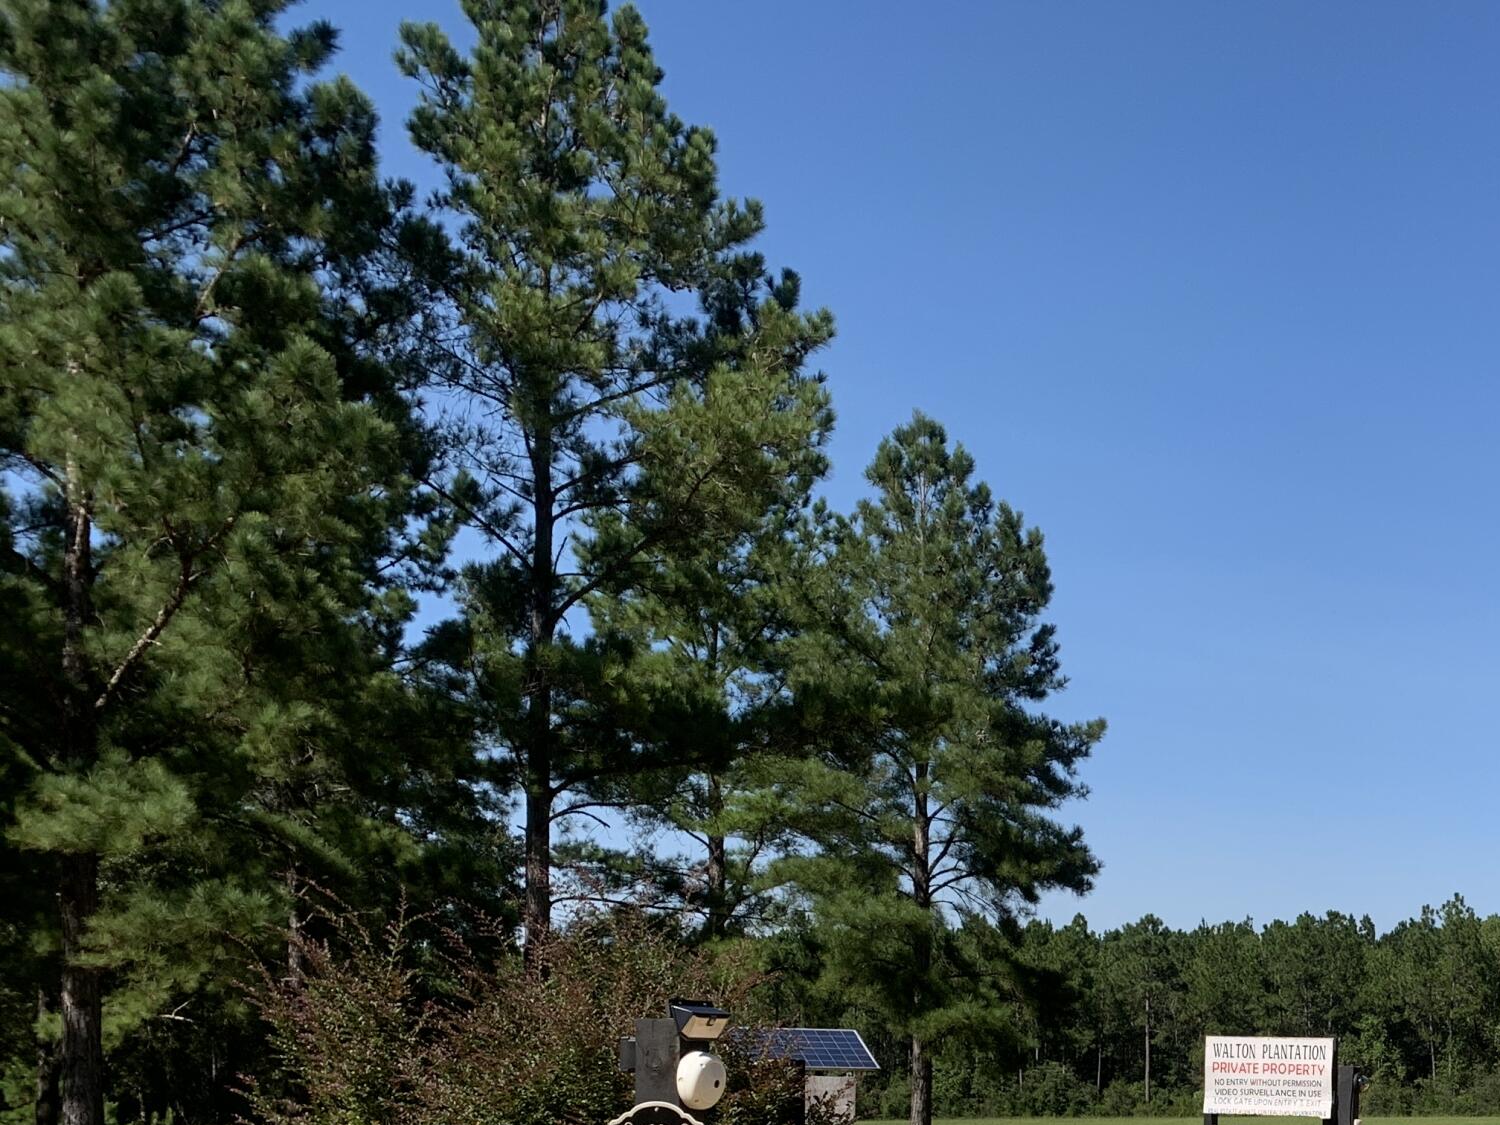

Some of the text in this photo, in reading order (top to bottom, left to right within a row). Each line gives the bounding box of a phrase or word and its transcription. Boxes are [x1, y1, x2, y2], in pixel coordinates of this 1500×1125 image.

[1213, 1043, 1327, 1060] WALTON PLANTATION
[1212, 1061, 1325, 1076] PRIVATE PROPERTY
[1214, 1078, 1322, 1088] NO ENTRY WITHOUT PERMISSION
[1214, 1088, 1322, 1098] VIDEO SURVEILLANCE IN USE
[1214, 1097, 1231, 1105] LOCK
[1233, 1097, 1253, 1106] GATE
[1254, 1098, 1273, 1106] UPON
[1306, 1100, 1321, 1108] EXIT
